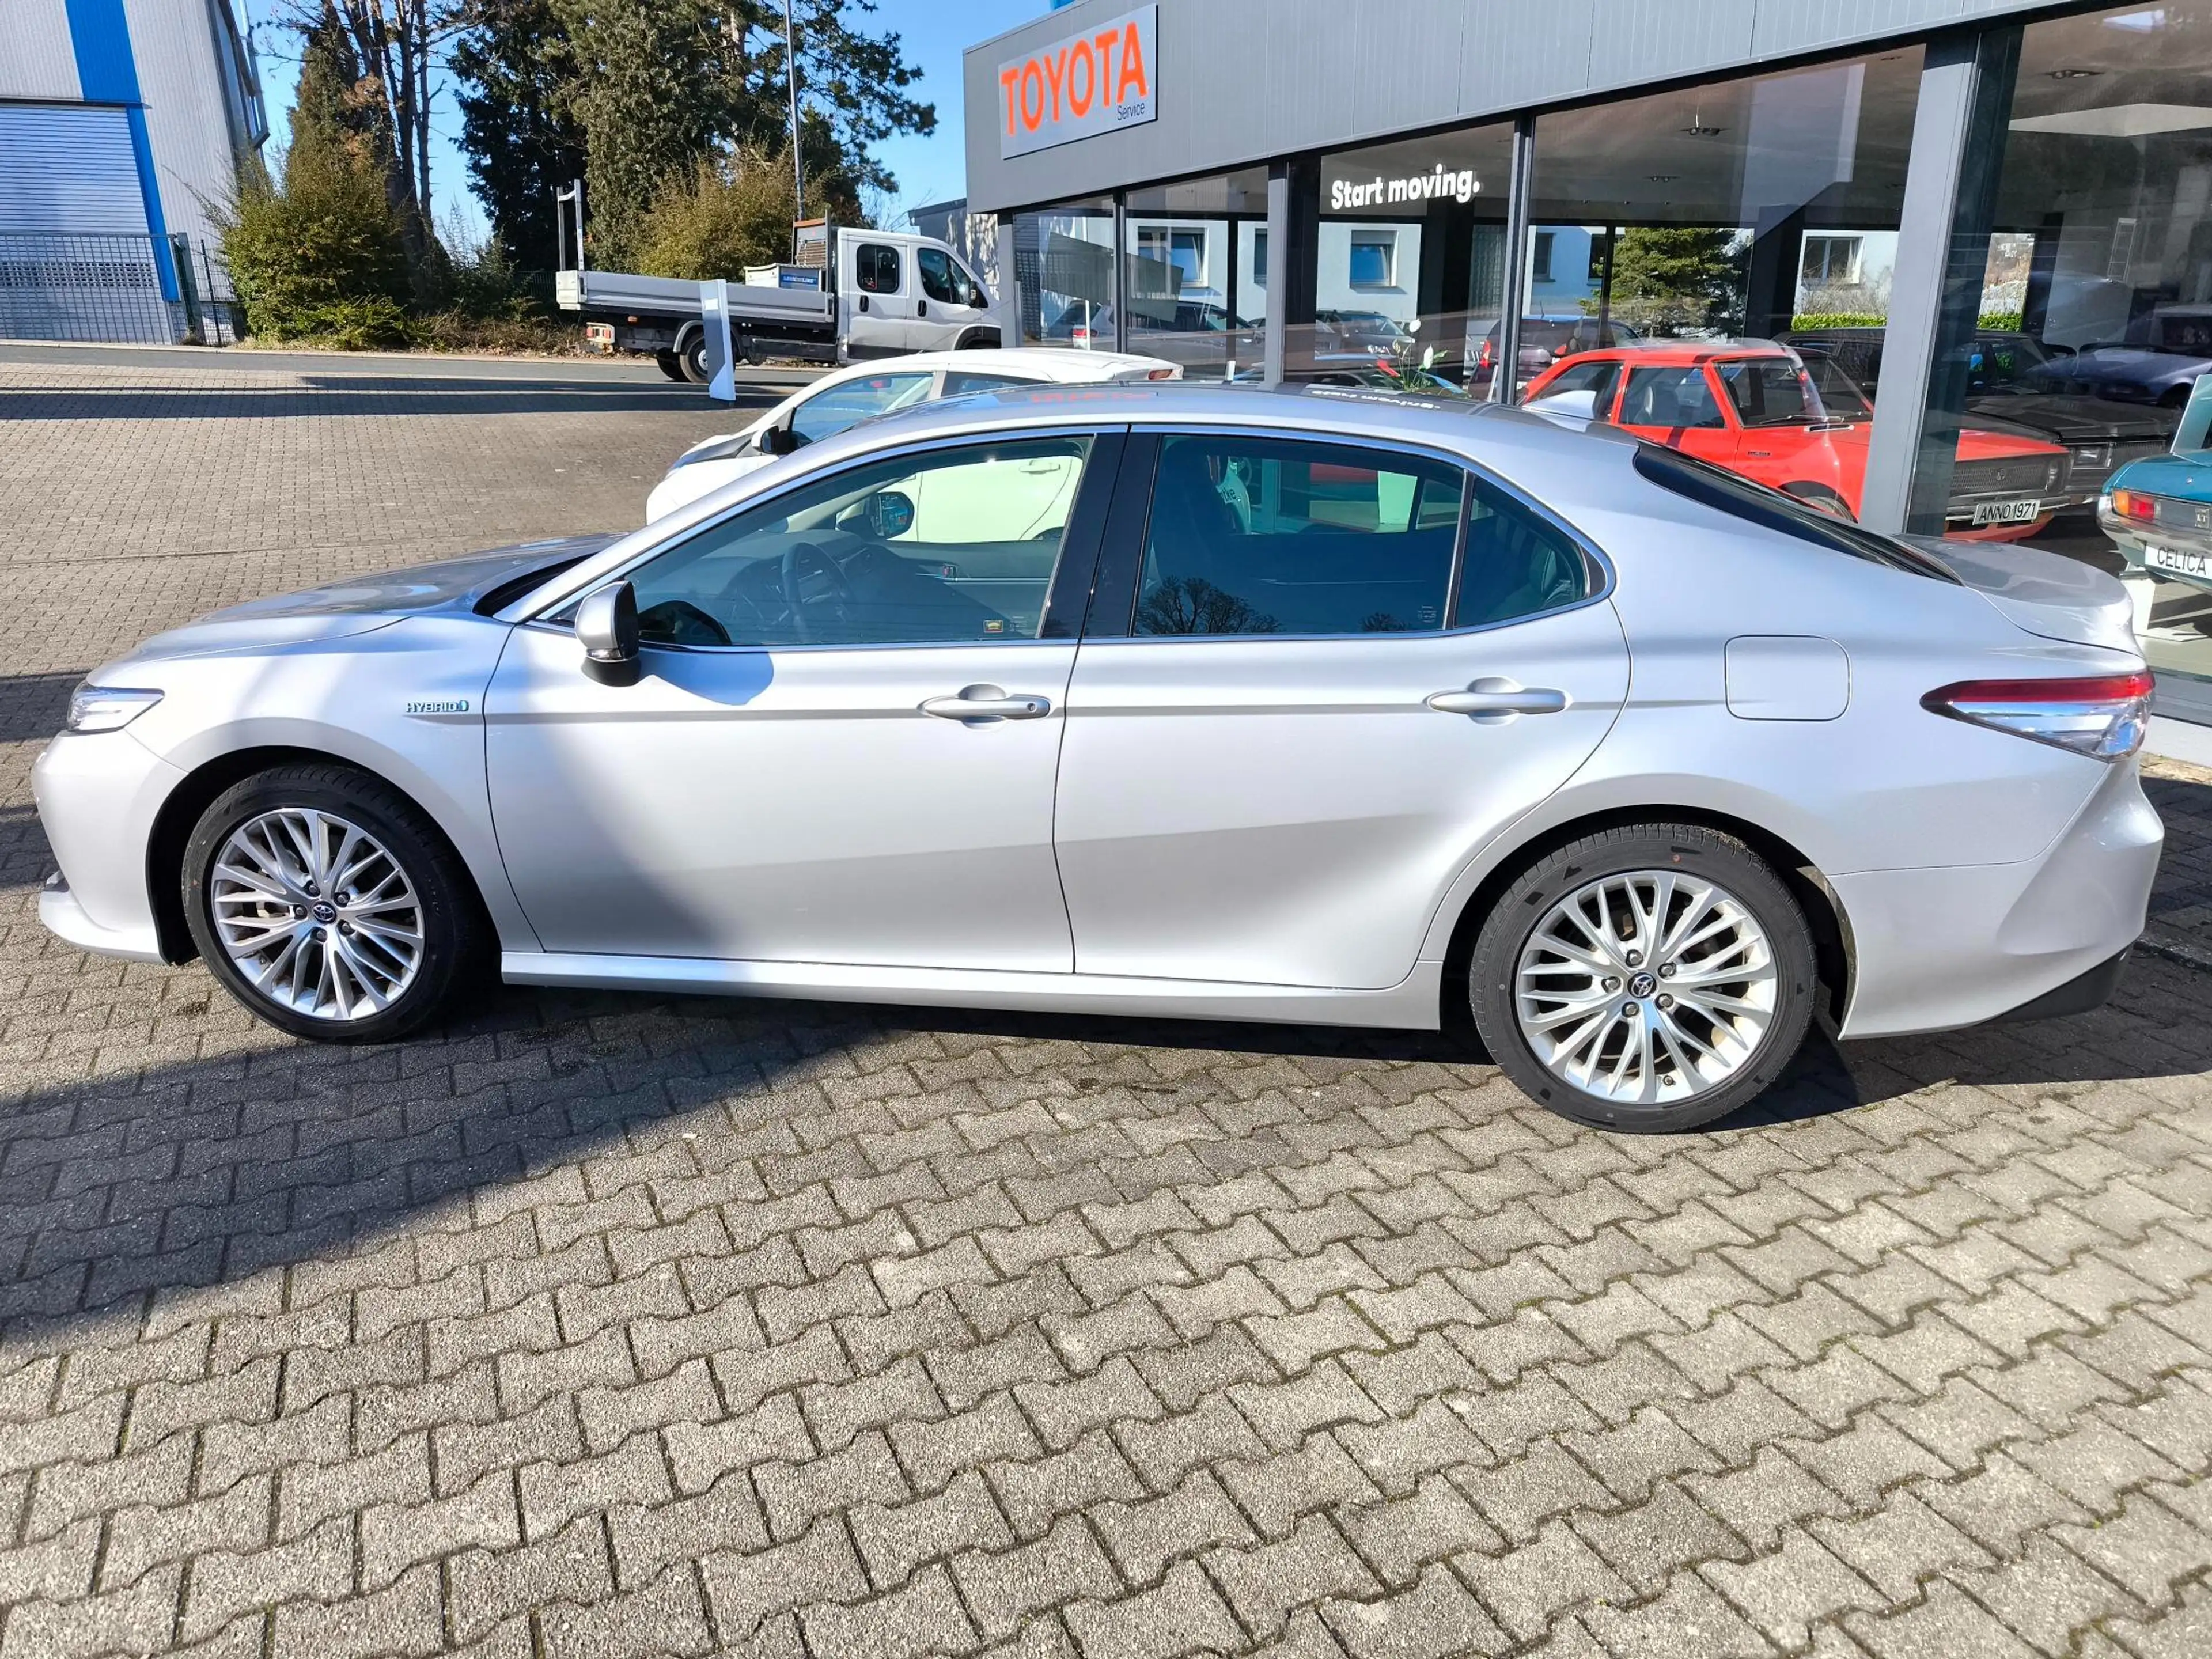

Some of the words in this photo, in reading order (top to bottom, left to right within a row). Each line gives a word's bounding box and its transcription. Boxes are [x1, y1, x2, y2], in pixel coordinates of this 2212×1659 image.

[1001, 21, 1147, 136] TOYOTA
[1117, 102, 1145, 120] Service
[1331, 177, 1383, 209] Start
[1388, 164, 1480, 203] moving.
[1979, 504, 2011, 521] ANNO
[2013, 502, 2036, 518] 1971
[2158, 546, 2206, 575] CELICA
[406, 702, 459, 712] HYBRID
